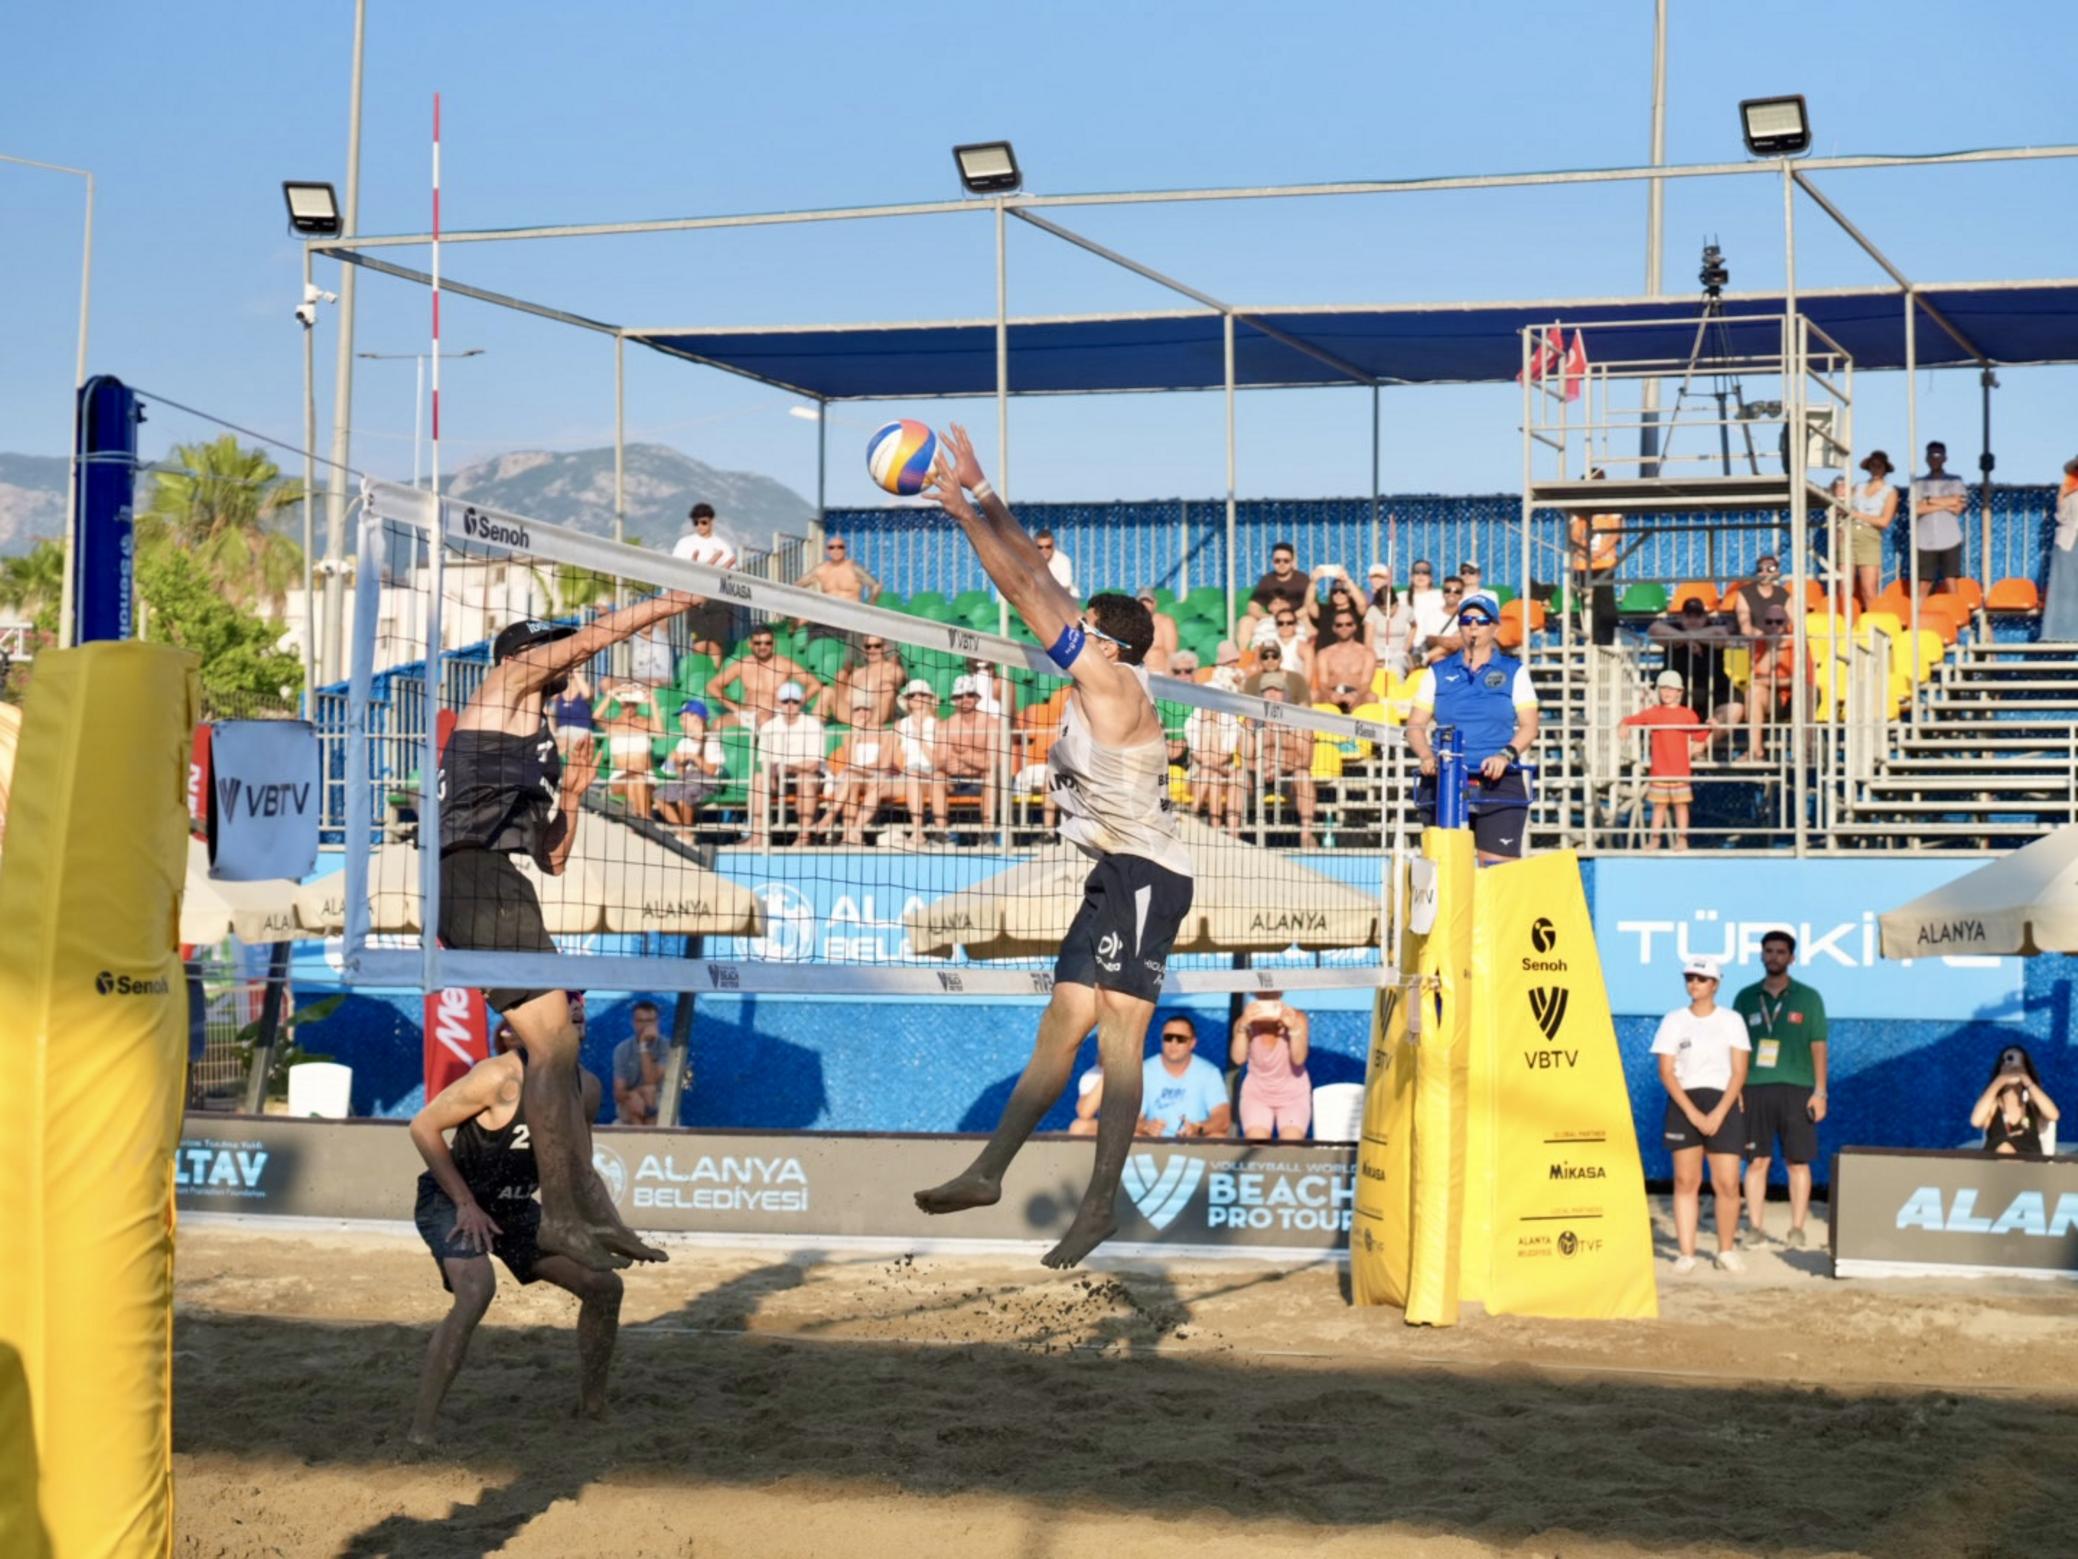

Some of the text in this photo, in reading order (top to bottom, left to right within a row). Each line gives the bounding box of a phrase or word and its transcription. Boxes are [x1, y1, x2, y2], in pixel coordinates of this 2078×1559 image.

[479, 516, 529, 548] Senoh
[247, 782, 310, 817] VBTV
[642, 900, 711, 919] ALANYA
[826, 895, 925, 929] ALA
[1250, 911, 1328, 932] ALANYA
[264, 914, 291, 931] ALA
[1917, 920, 1986, 944] ALANYA
[1522, 957, 1568, 971] Senoh
[117, 976, 168, 995] Senoh
[1524, 1049, 1578, 1069] VBTV
[510, 1124, 530, 1149] 2
[175, 1148, 268, 1187] LTAV
[635, 1155, 807, 1184] ALANYA
[1210, 1161, 1300, 1172] VOLLEYBALL
[634, 1186, 808, 1211] BELEDİYESİ
[1208, 1173, 1357, 1207] BEACH
[1208, 1206, 1273, 1229] PRO
